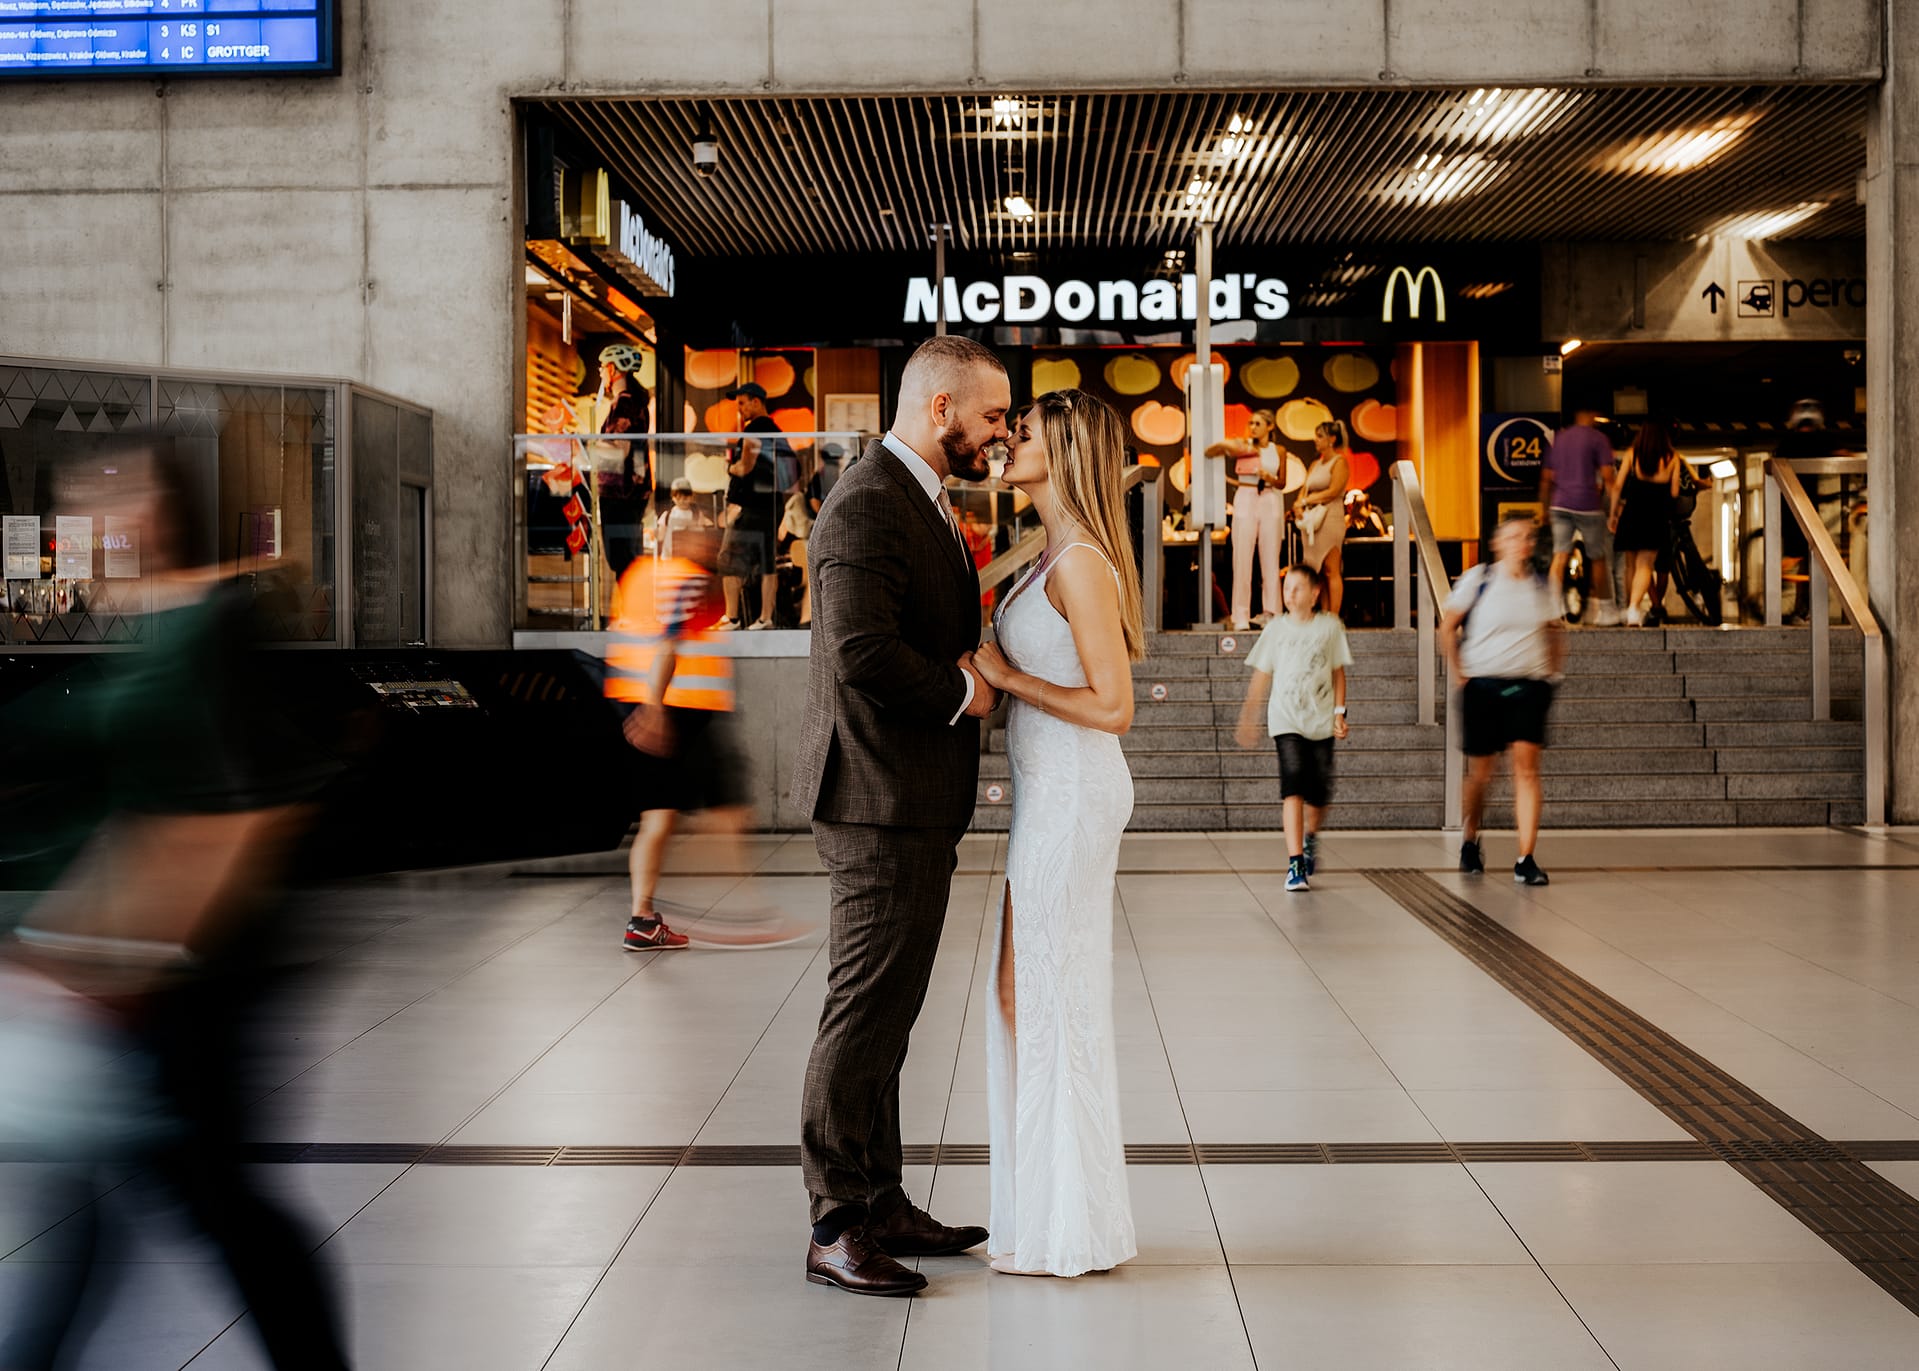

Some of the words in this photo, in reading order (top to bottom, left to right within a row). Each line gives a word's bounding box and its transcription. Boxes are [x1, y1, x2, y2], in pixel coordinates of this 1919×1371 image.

[161, 25, 169, 37] 3
[180, 24, 197, 37] KS
[206, 24, 220, 36] S1
[161, 47, 169, 59] 4
[181, 46, 194, 59] IC
[207, 45, 270, 58] GROTTGER
[903, 273, 1290, 323] McDonald's
[1511, 437, 1542, 459] 24
